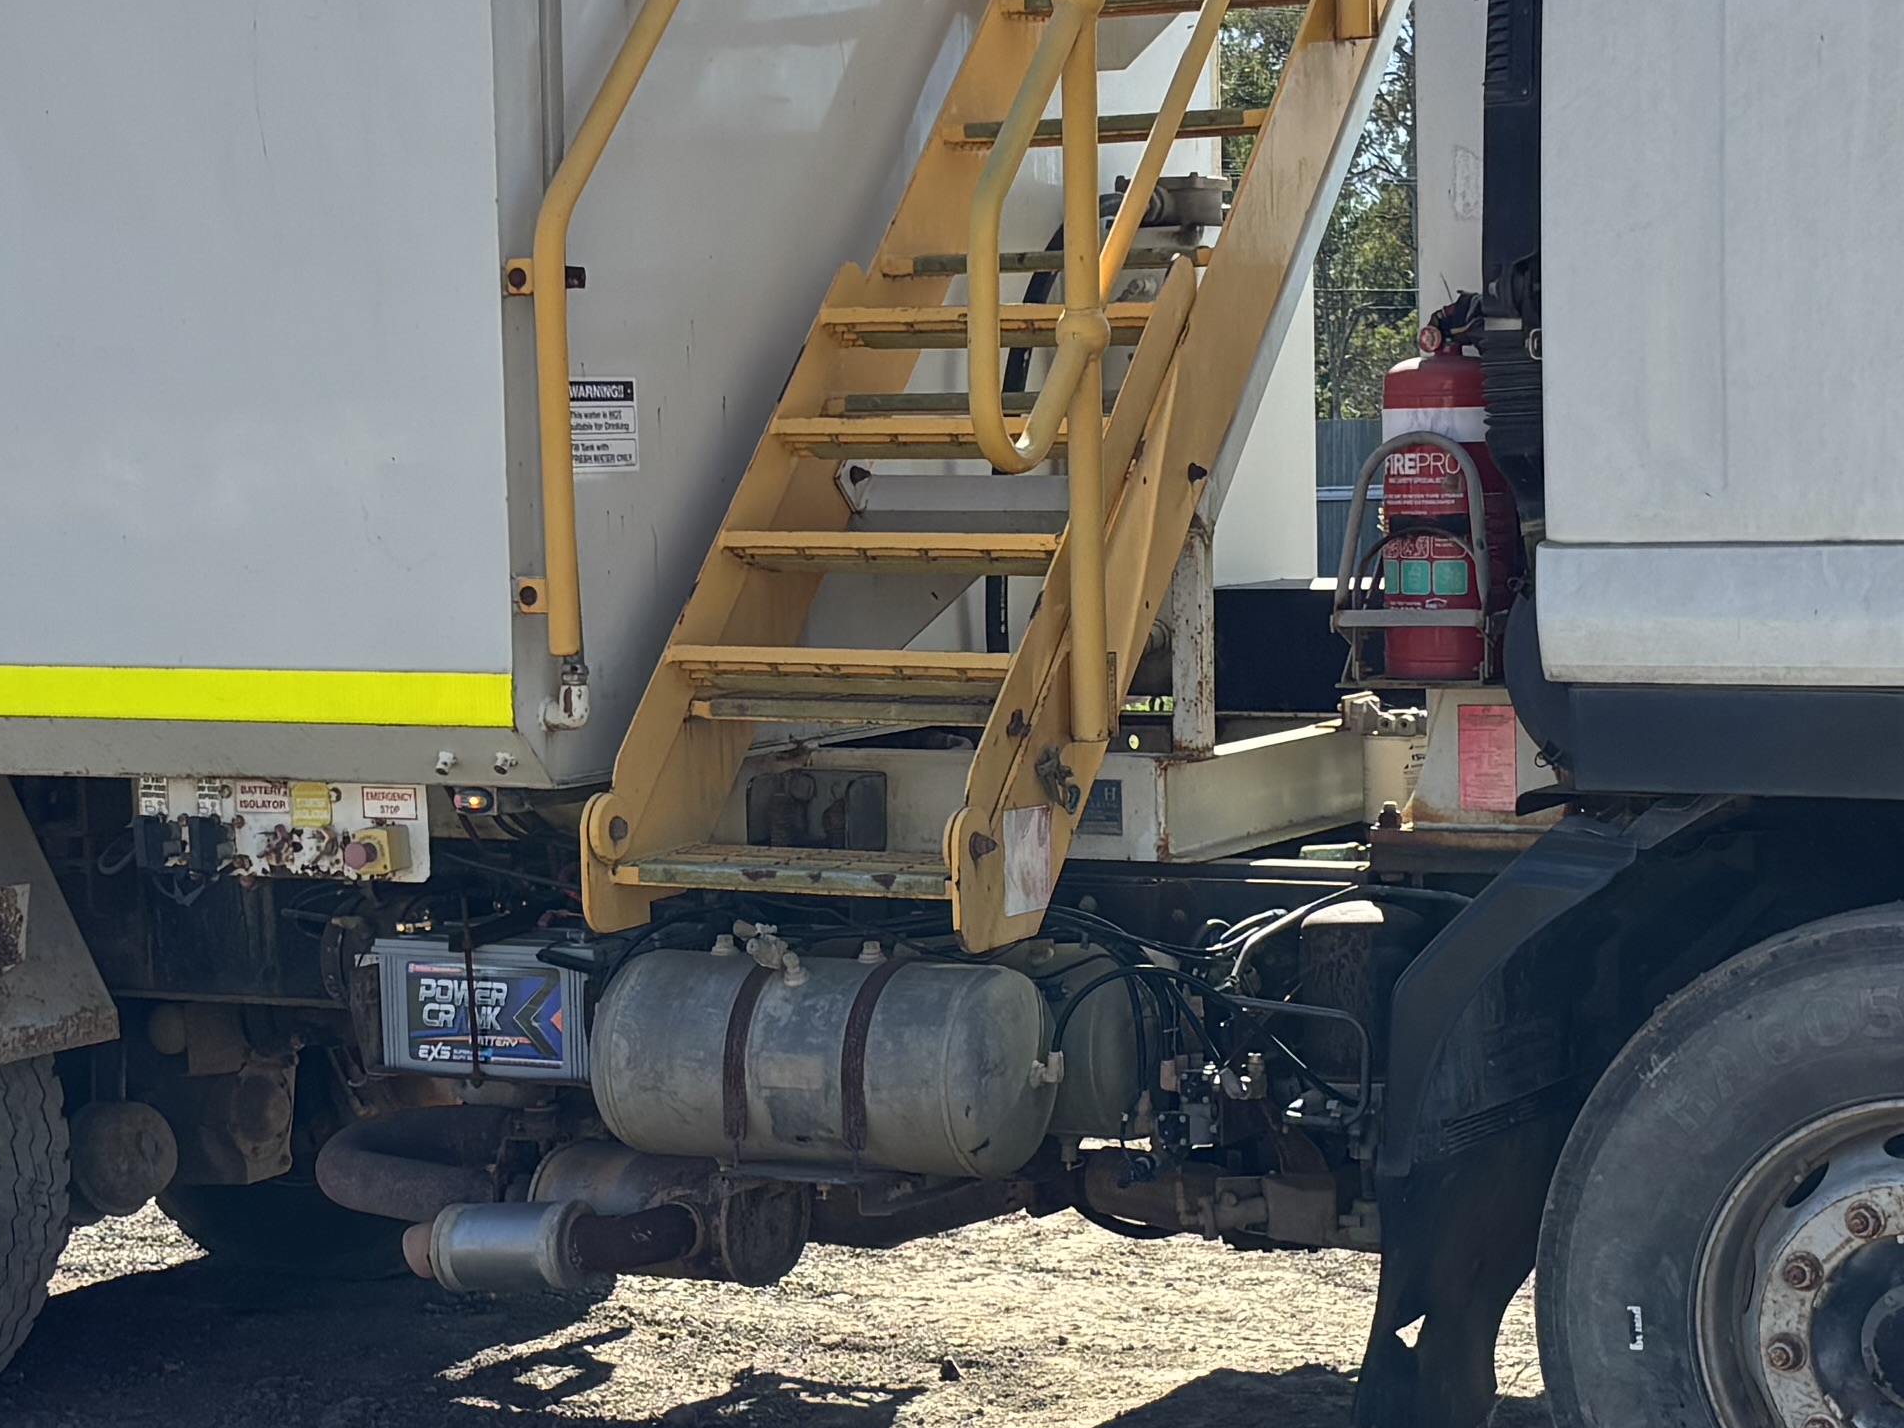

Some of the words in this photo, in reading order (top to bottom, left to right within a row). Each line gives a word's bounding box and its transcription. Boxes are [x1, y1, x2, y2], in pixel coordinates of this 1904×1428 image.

[1385, 453, 1461, 475] FIREPRO
[240, 784, 283, 795] BATTERY
[365, 791, 412, 802] EMERGENCY
[239, 799, 286, 810] ISOLATOR
[379, 805, 401, 815] STOP
[418, 978, 508, 1007] POWER
